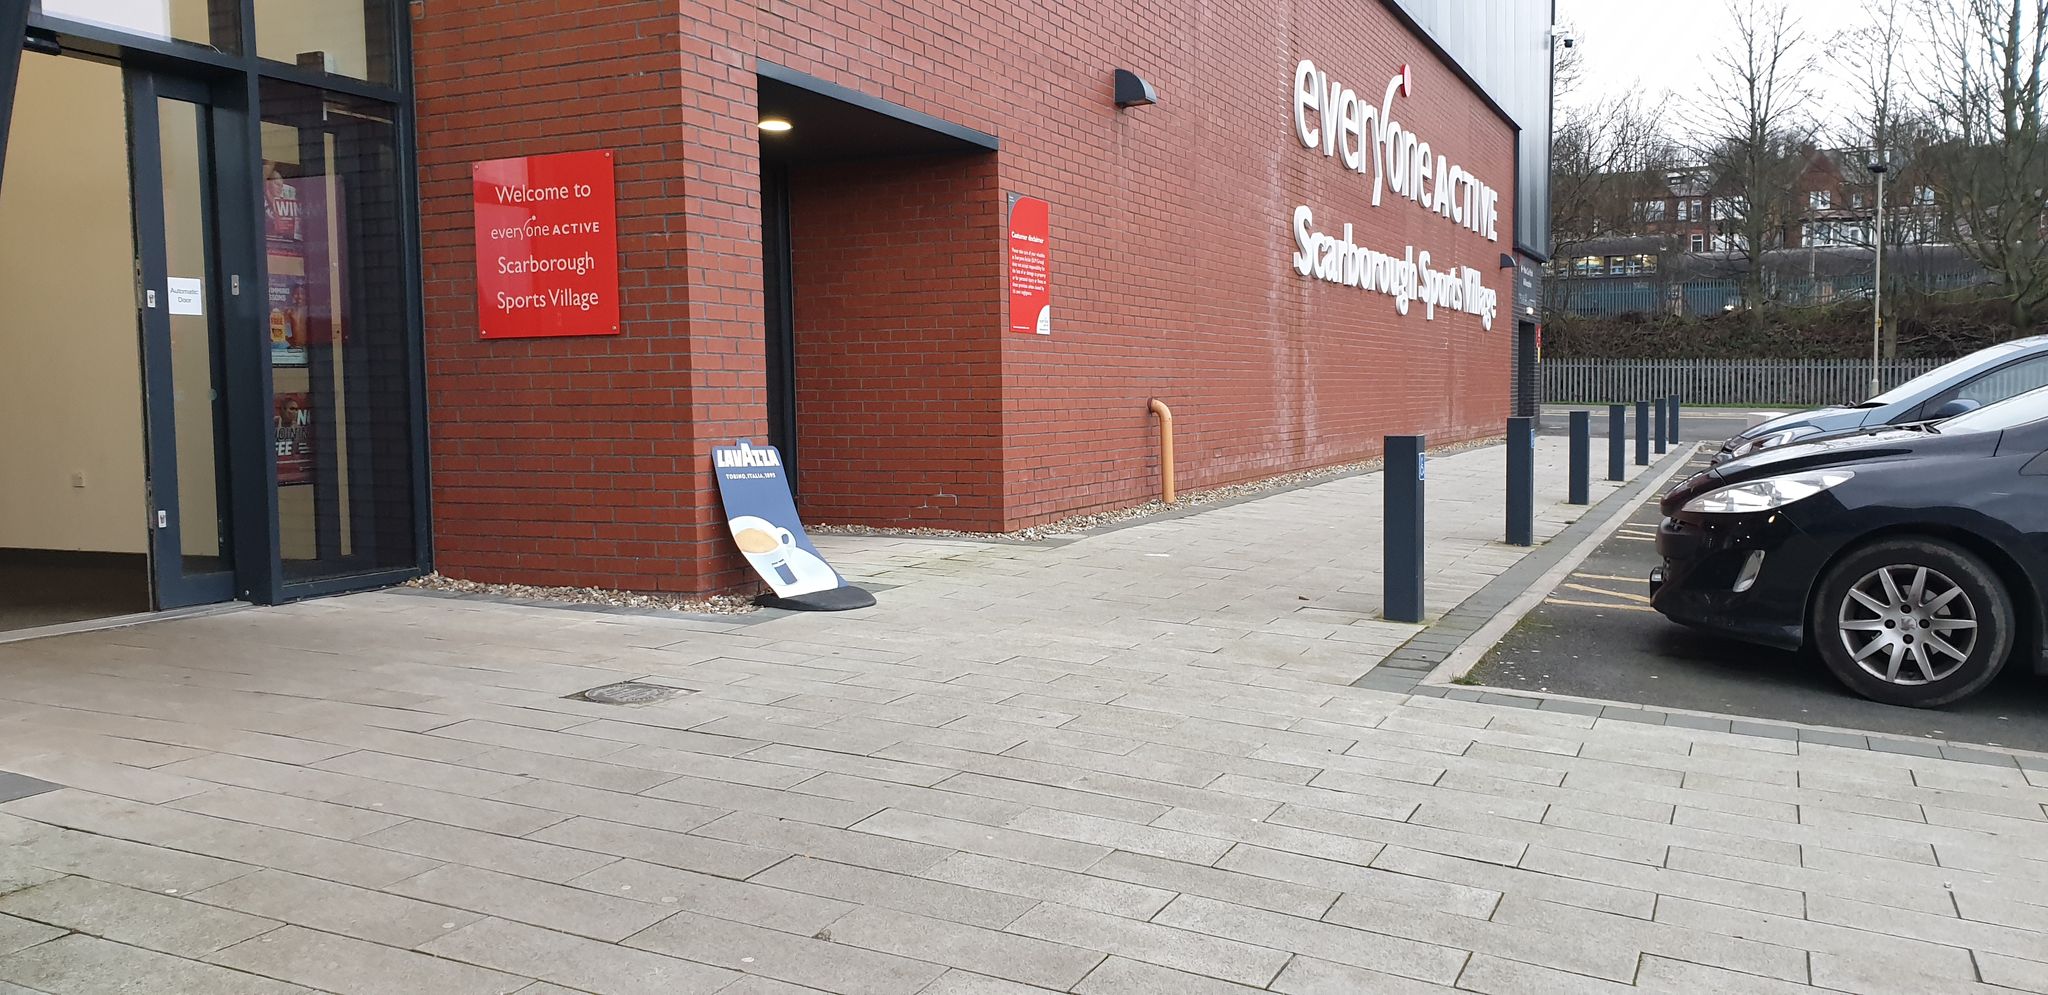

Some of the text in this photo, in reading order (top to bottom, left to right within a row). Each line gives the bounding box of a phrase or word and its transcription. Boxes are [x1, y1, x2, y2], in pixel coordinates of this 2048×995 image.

[1294, 59, 1498, 242] everyone ACTIVE
[495, 183, 591, 203] Welcome to
[491, 215, 600, 240] everyone ACTIVE
[498, 251, 595, 275] Scarborough
[1293, 205, 1497, 331] Scarborough Sports Village
[170, 287, 200, 295] Automatic
[497, 288, 599, 314] Sports Village
[717, 443, 780, 467] LAVAZZA
